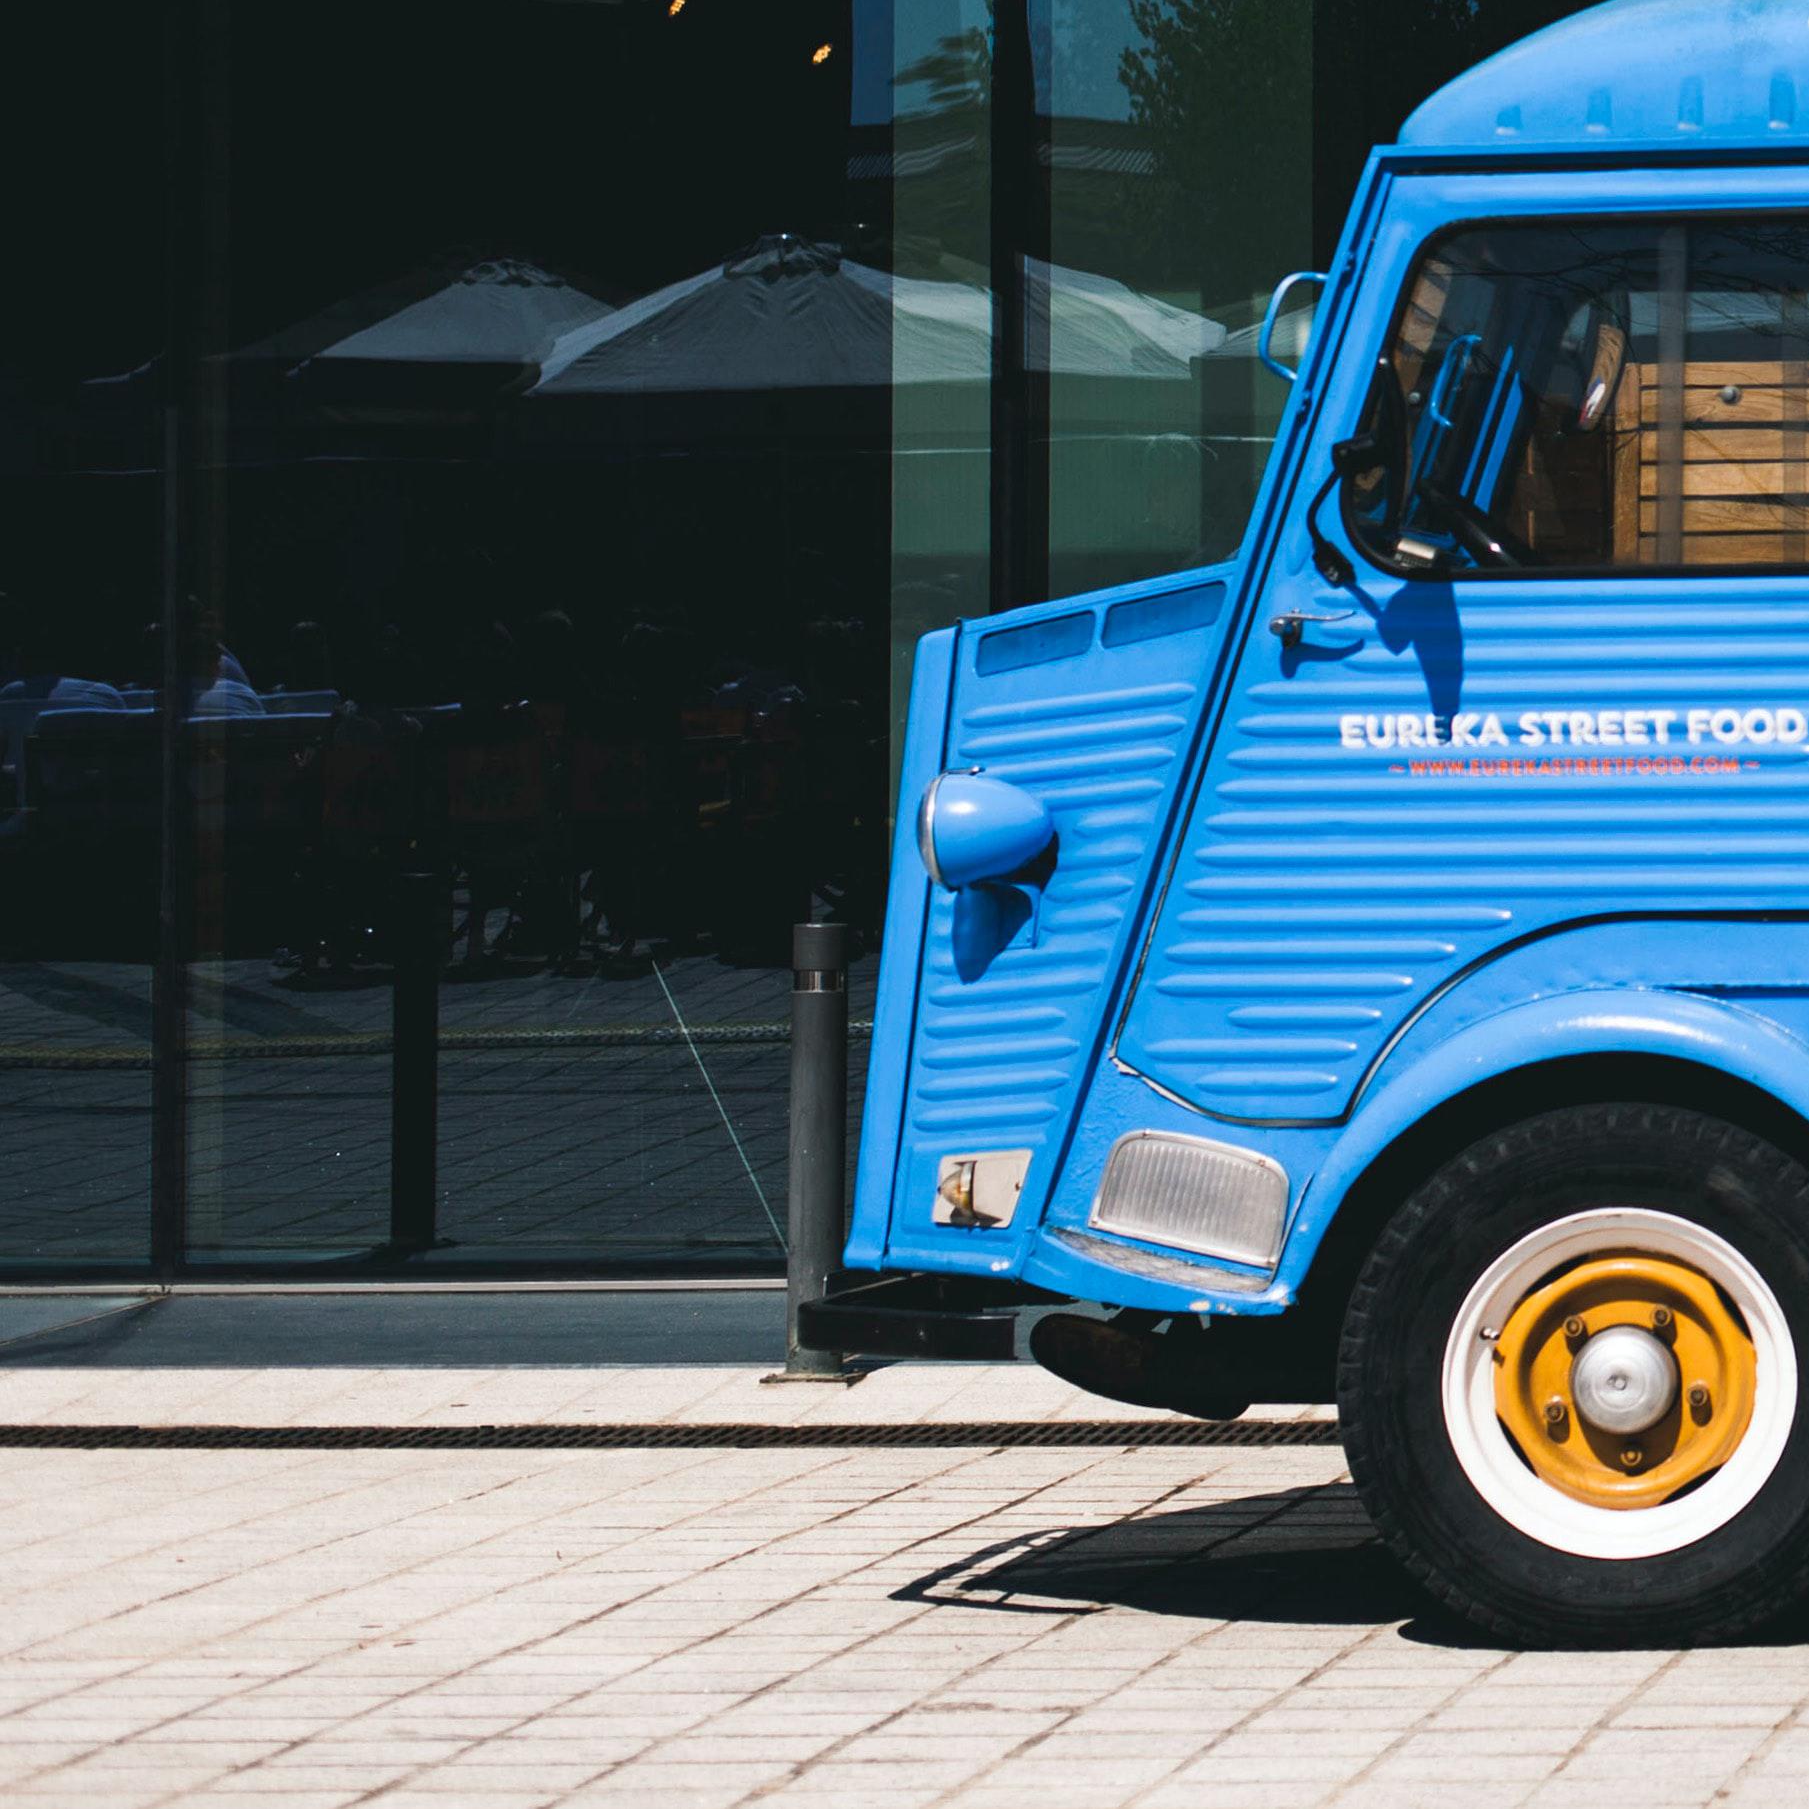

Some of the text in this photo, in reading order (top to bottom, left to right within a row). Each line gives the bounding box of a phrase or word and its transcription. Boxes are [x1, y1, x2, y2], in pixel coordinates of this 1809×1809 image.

[1338, 708, 1809, 749] EUREKA STREET FOOD
[1409, 758, 1739, 776] WWW.EUREKASTREETFOOD.COM
